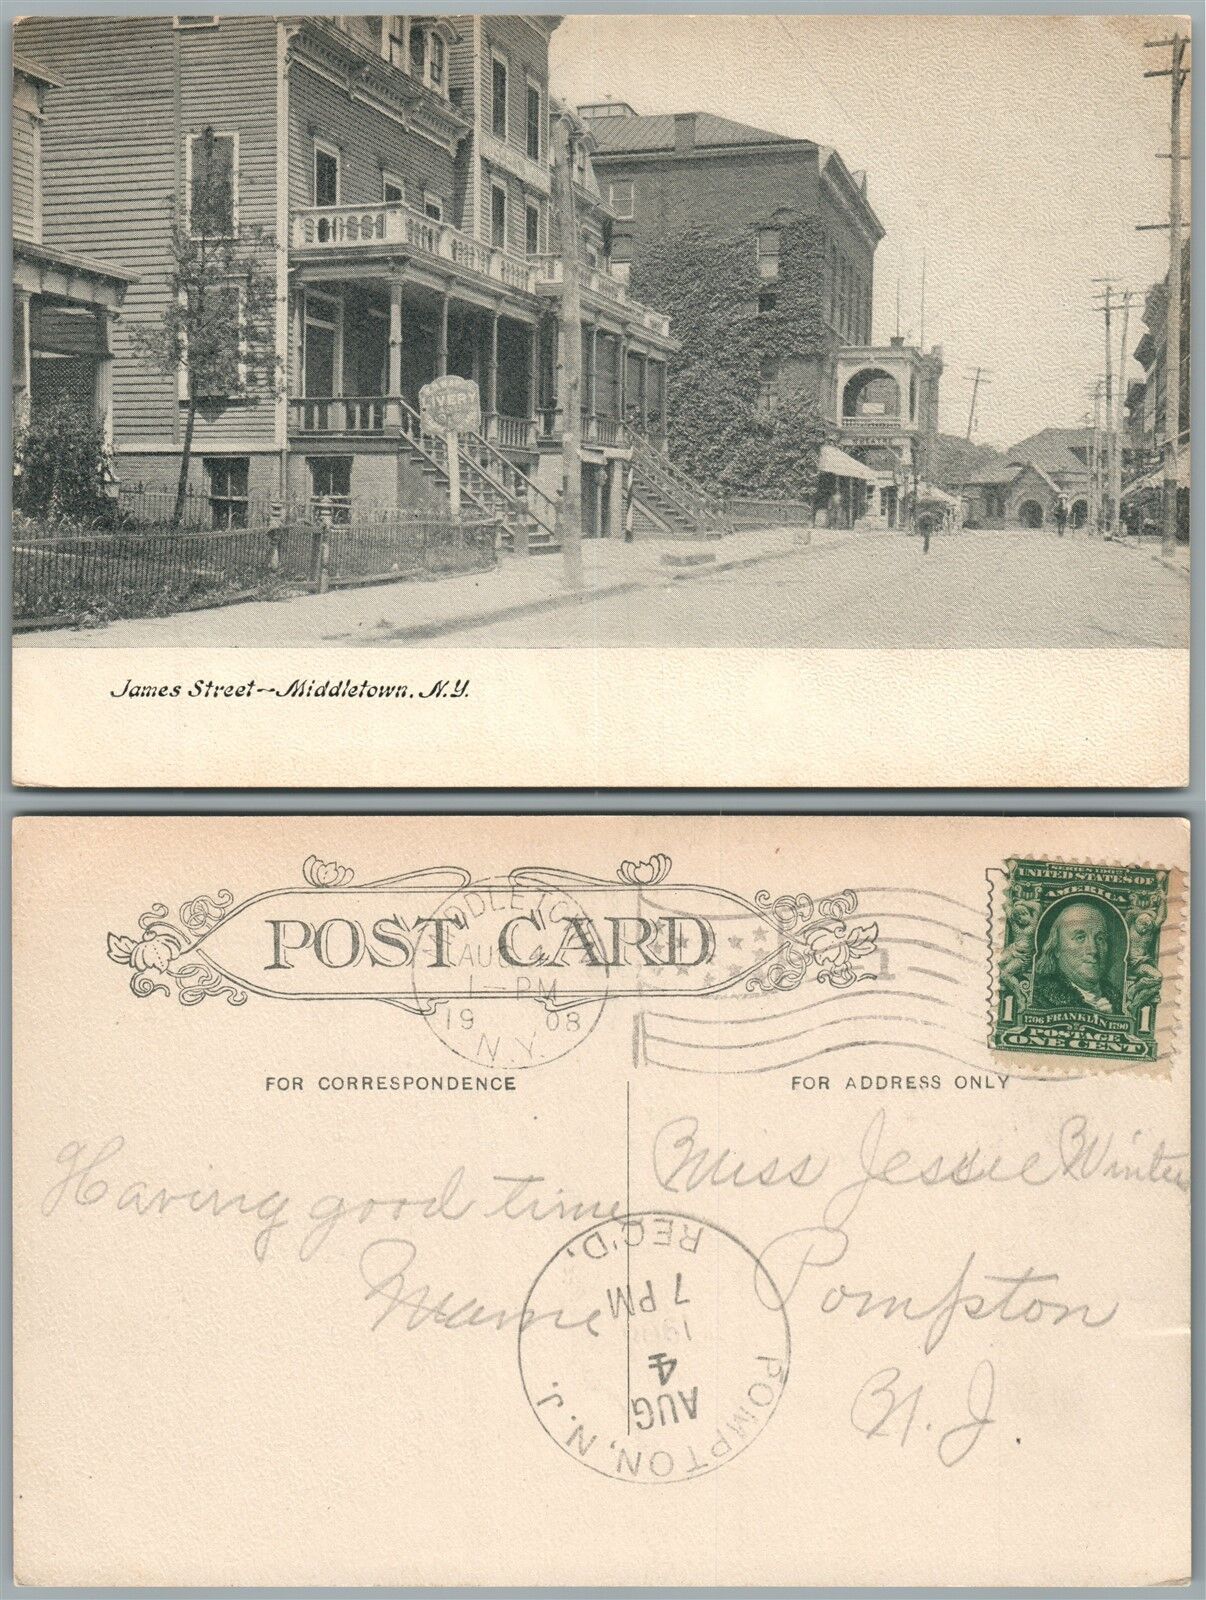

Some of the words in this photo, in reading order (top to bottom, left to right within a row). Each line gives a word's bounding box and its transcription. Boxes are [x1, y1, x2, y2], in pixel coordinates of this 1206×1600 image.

[421, 391, 476, 407] LIVERY
[110, 679, 181, 698] James
[418, 679, 471, 698] N.Y.
[1019, 868, 1074, 881] UNITED
[1074, 873, 1133, 885] STATES
[1134, 875, 1158, 886] OF
[1046, 885, 1128, 902] AMERICA
[264, 915, 466, 971] POST
[498, 910, 716, 968] CARD
[1003, 995, 1014, 1022] 1
[1046, 1012, 1108, 1029] FRANKLIN
[1139, 1005, 1151, 1032] 1
[1008, 1034, 1066, 1047] ONE
[1069, 1038, 1146, 1053] CENT
[1029, 1027, 1121, 1043] POSTAGE
[265, 1076, 304, 1091] FOR
[318, 1076, 517, 1091] CORRESPONDENCE
[791, 1075, 830, 1090] FOR
[845, 1075, 941, 1090] ADDRESS
[954, 1074, 1010, 1090] ONLY
[652, 1116, 832, 1193] Miss
[822, 1107, 1059, 1231] Jessie
[41, 1134, 289, 1263] Having
[299, 1165, 476, 1262] good
[484, 1174, 645, 1226] time
[606, 1279, 657, 1319] PM
[673, 1272, 691, 1305] 7
[753, 1226, 1120, 1356] Pompton
[648, 1352, 678, 1386] 4
[630, 1386, 699, 1431] AUG
